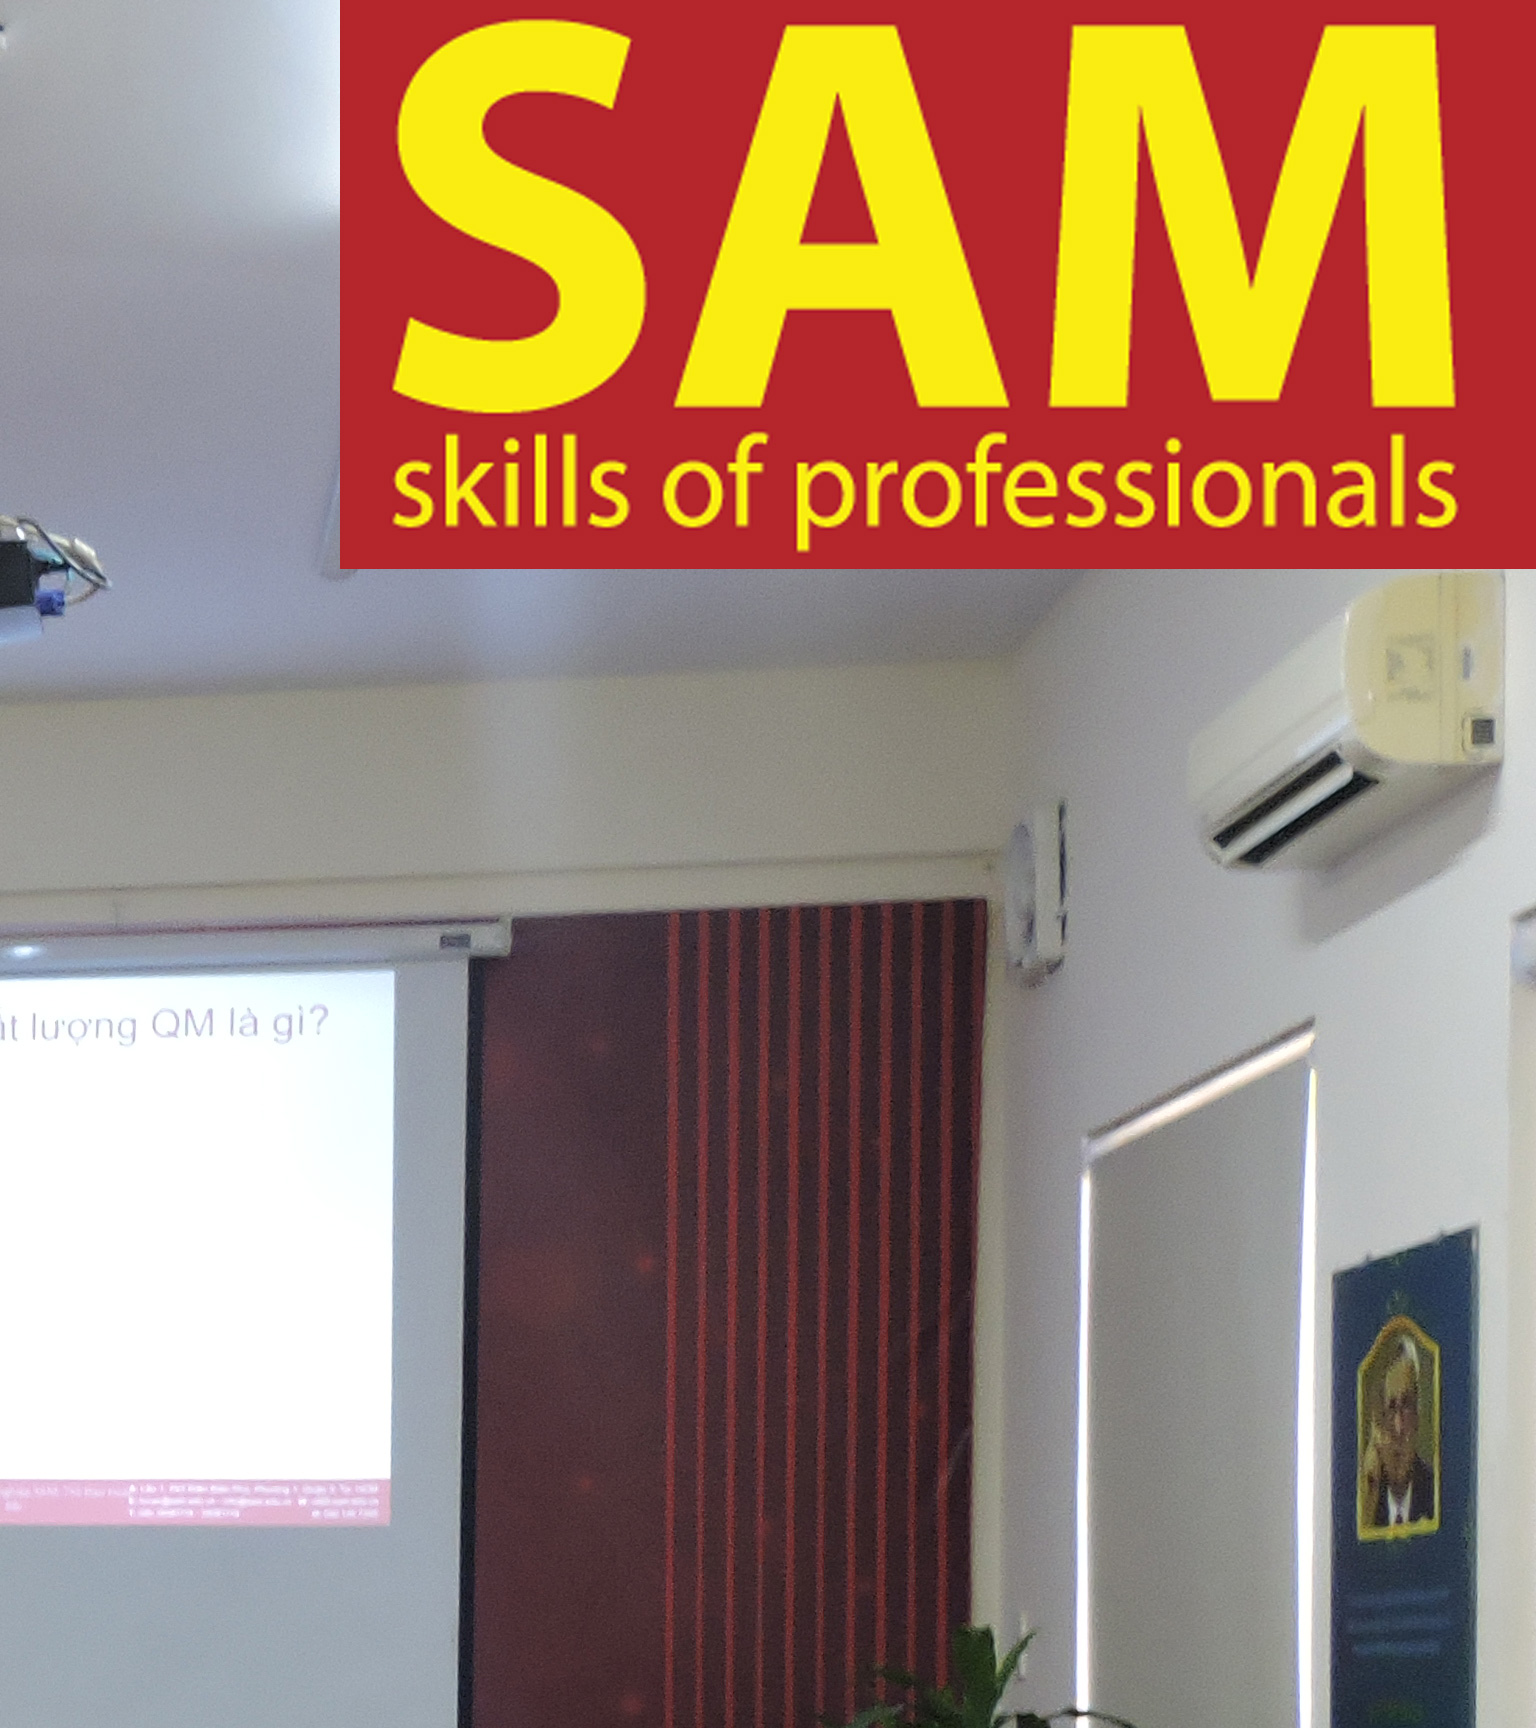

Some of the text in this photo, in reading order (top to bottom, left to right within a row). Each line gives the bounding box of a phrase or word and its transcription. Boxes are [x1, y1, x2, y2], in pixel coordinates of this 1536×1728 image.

[31, 1011, 137, 1047] lượng
[151, 1007, 214, 1039] QM
[229, 1006, 259, 1038] là
[272, 1003, 330, 1045] gì?
